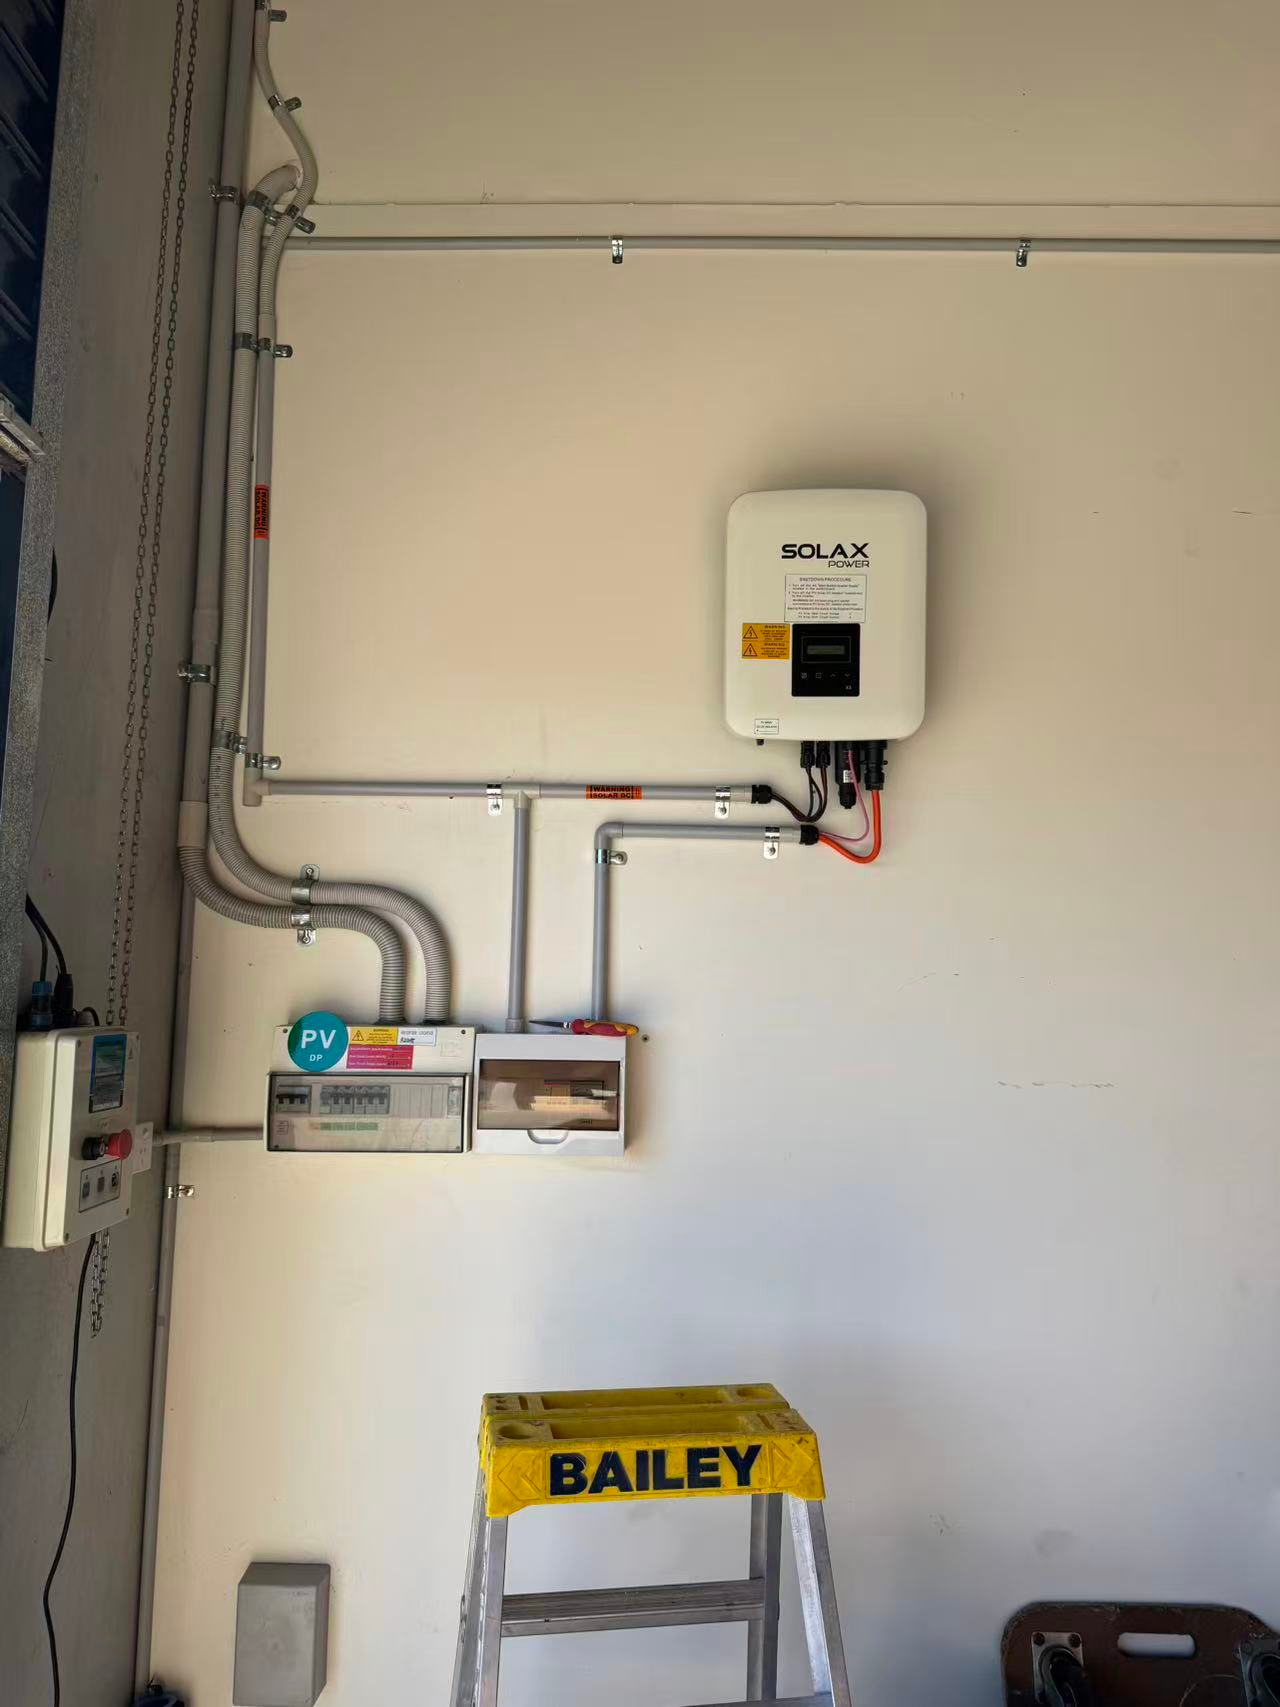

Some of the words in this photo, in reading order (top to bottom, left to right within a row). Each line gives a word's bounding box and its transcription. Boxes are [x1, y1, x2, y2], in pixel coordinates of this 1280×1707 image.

[781, 543, 869, 559] SOLAX
[828, 560, 870, 568] POWER
[301, 1029, 337, 1049] PV
[309, 1054, 323, 1062] DP
[550, 1445, 763, 1496] BAILEY
